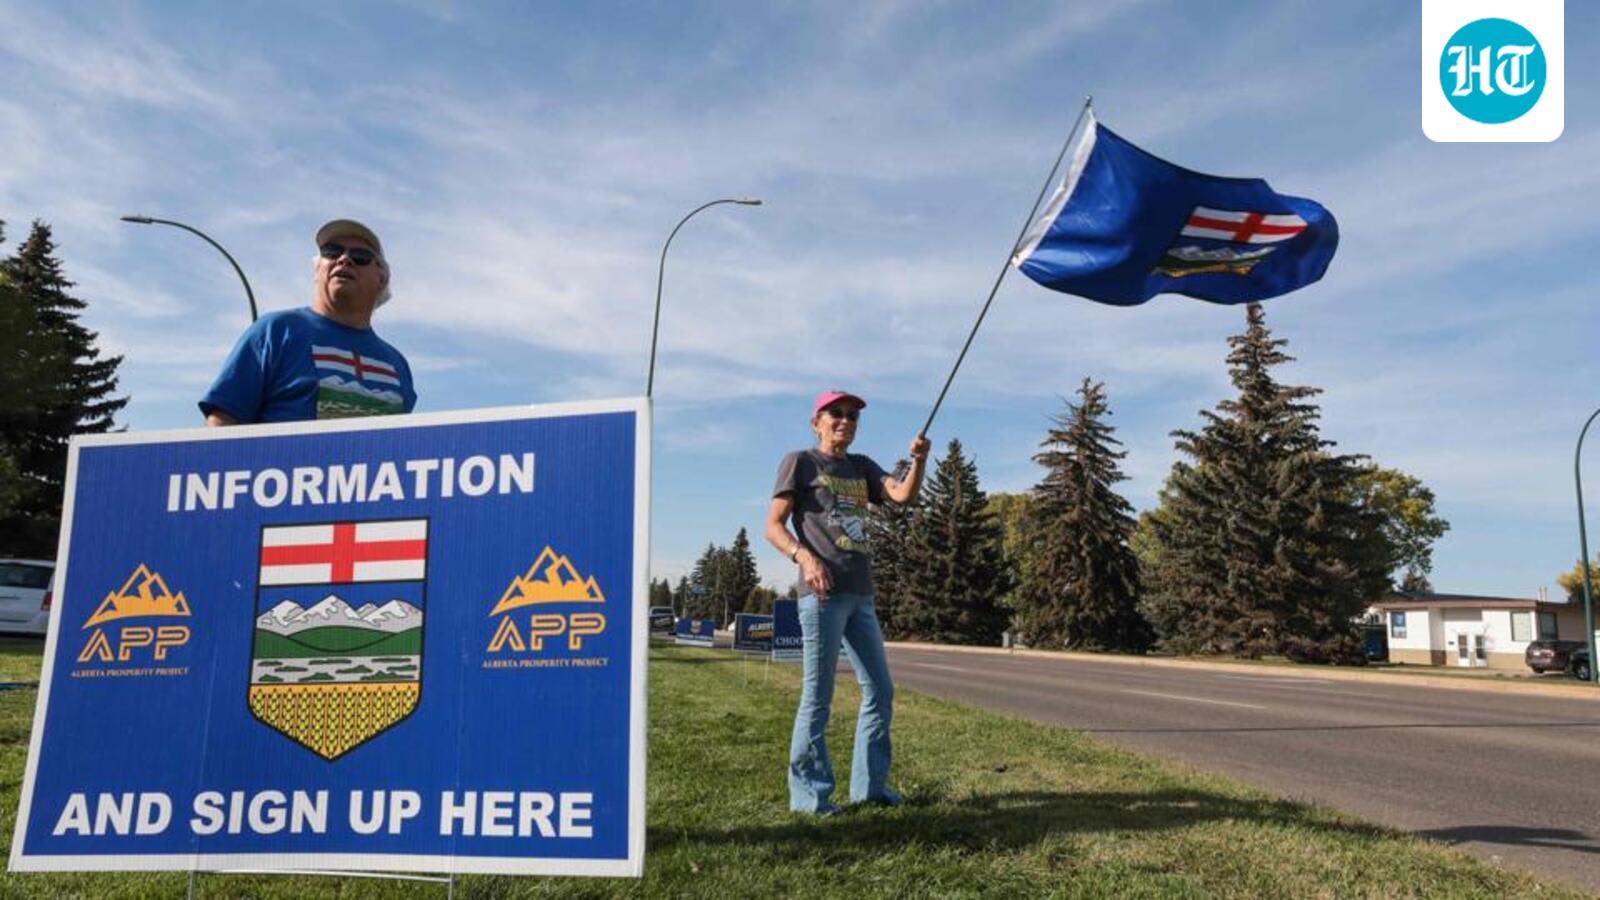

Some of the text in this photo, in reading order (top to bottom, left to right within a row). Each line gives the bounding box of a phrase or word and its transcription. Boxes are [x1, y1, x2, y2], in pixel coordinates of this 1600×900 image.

[166, 452, 536, 513] INFORMATION
[78, 626, 190, 662] APP
[488, 612, 606, 652] APP
[71, 666, 189, 677] ALBERTA PROSPERITY PROJECT
[482, 656, 609, 668] ALBERTA PROSPERITY PROJECT
[52, 790, 593, 838] AND SIGN UP HERE
